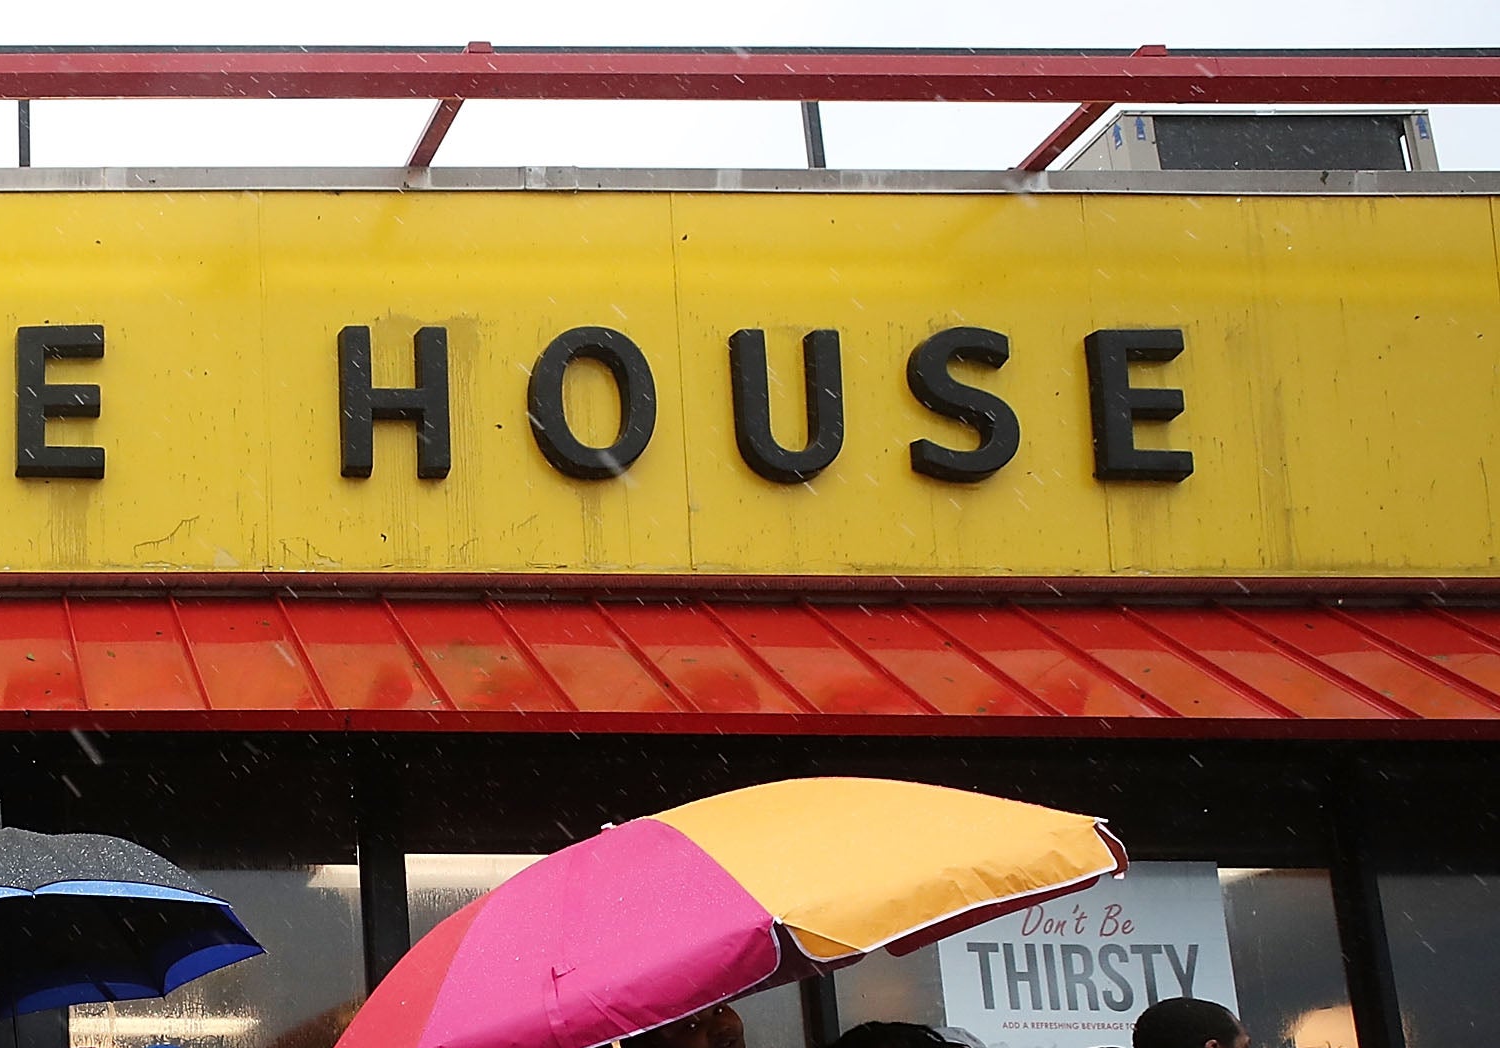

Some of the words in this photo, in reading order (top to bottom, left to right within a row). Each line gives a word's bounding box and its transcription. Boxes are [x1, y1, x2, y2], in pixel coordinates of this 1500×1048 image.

[338, 326, 1194, 489] HOUSE
[1021, 902, 1088, 937] Don't
[1099, 903, 1135, 937] Be
[967, 941, 1199, 1012] THIRSTY
[1002, 1021, 1021, 1030] ADD
[1022, 1022, 1029, 1030] A
[1031, 1021, 1080, 1030] REFRESHING
[1081, 1022, 1124, 1030] BEVERAGE
